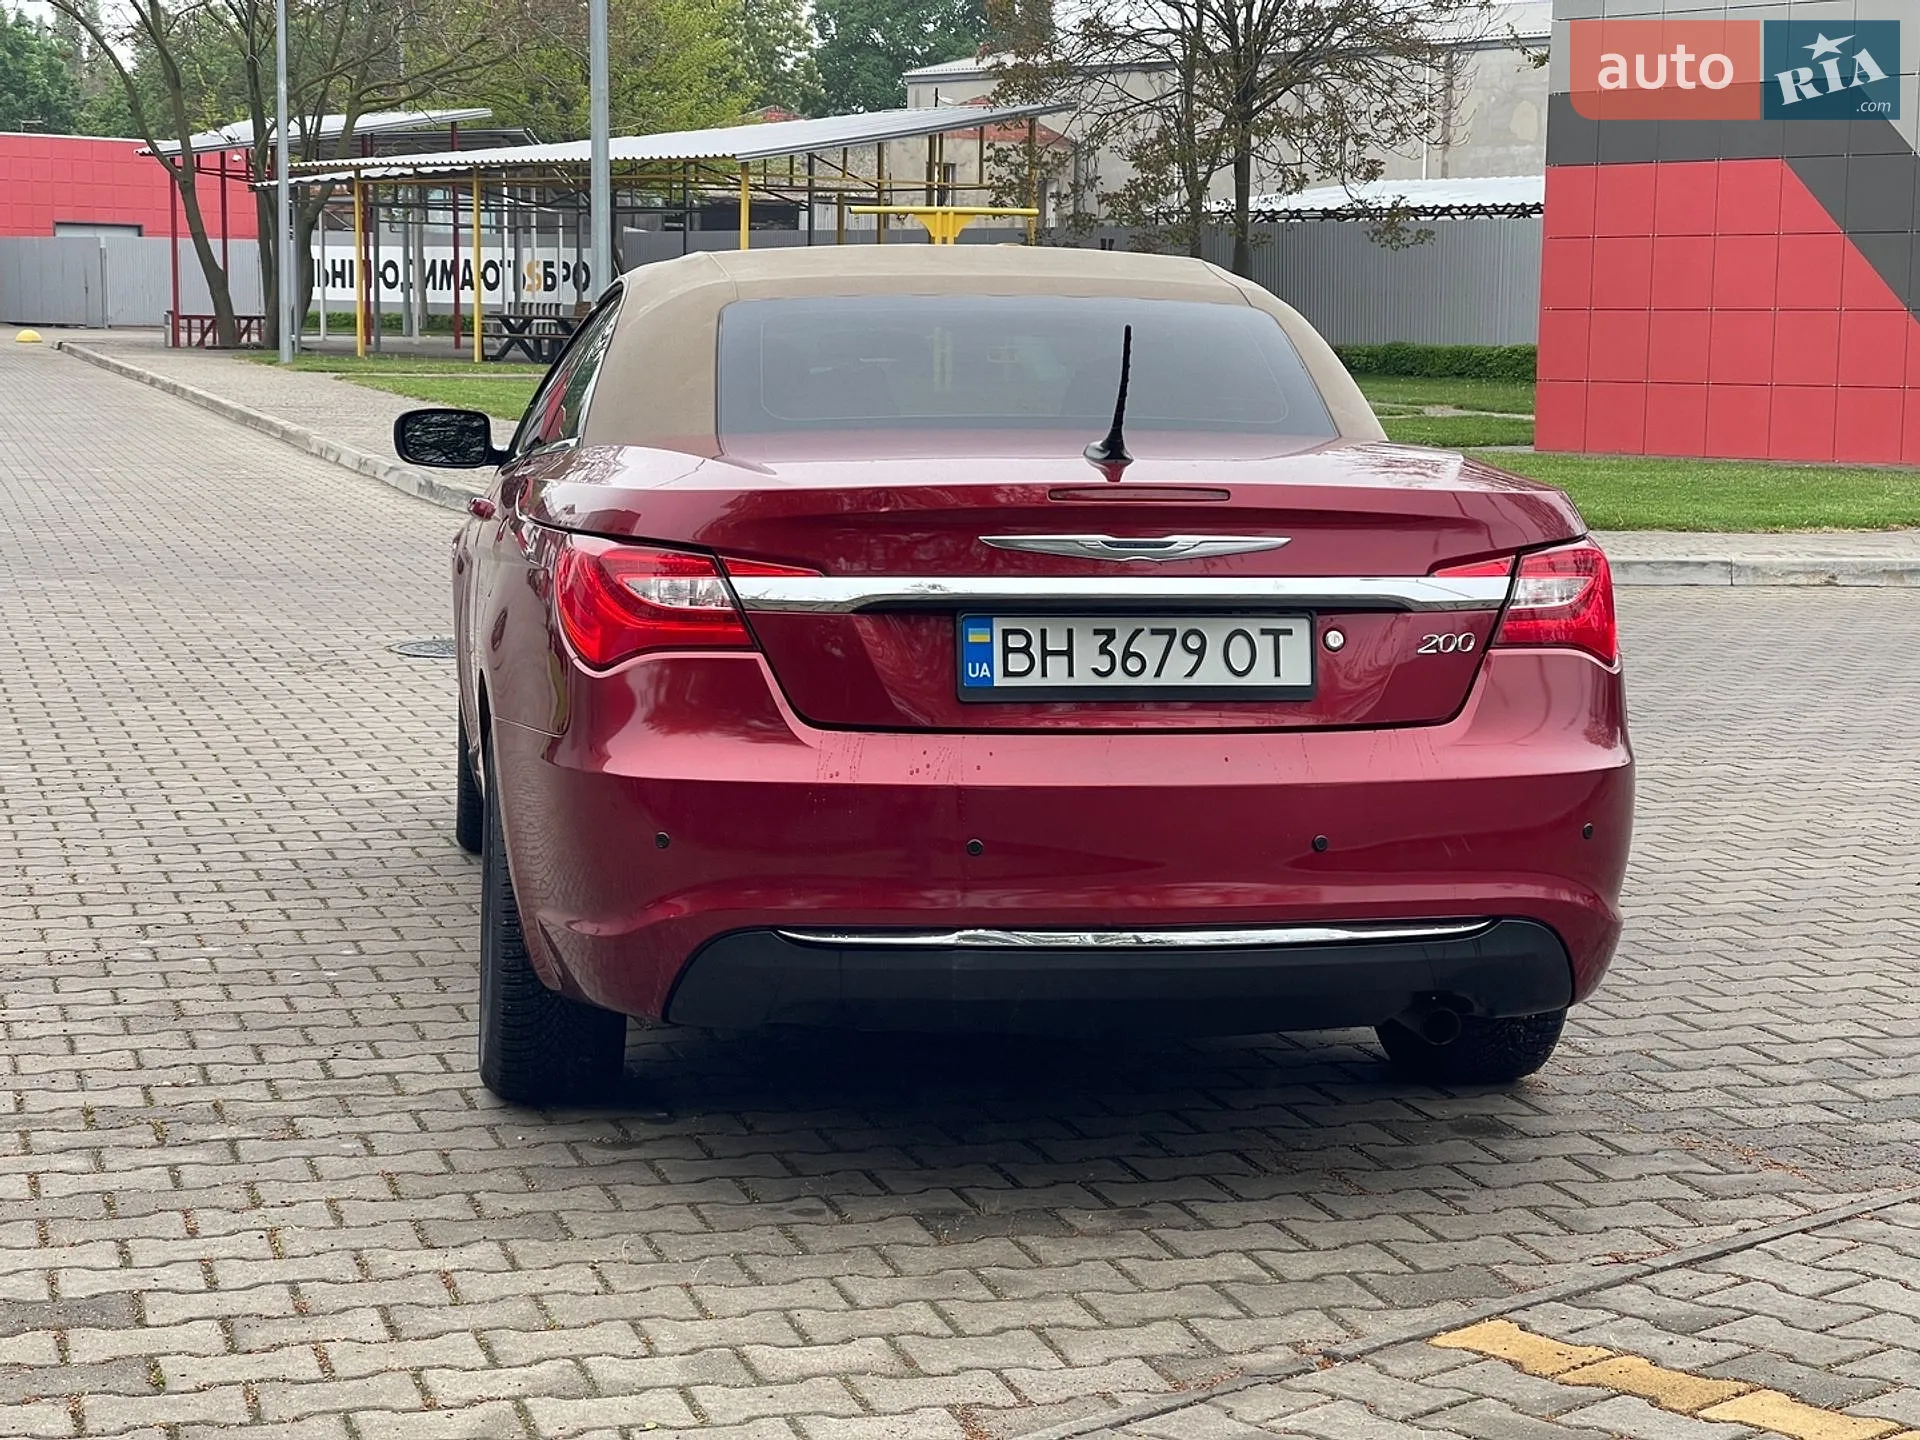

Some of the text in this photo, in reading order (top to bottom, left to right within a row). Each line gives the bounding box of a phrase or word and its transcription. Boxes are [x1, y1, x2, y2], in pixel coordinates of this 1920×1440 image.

[1001, 627, 1293, 678] BH 3679 OT
[1416, 631, 1476, 655] 200
[968, 662, 991, 678] UA
